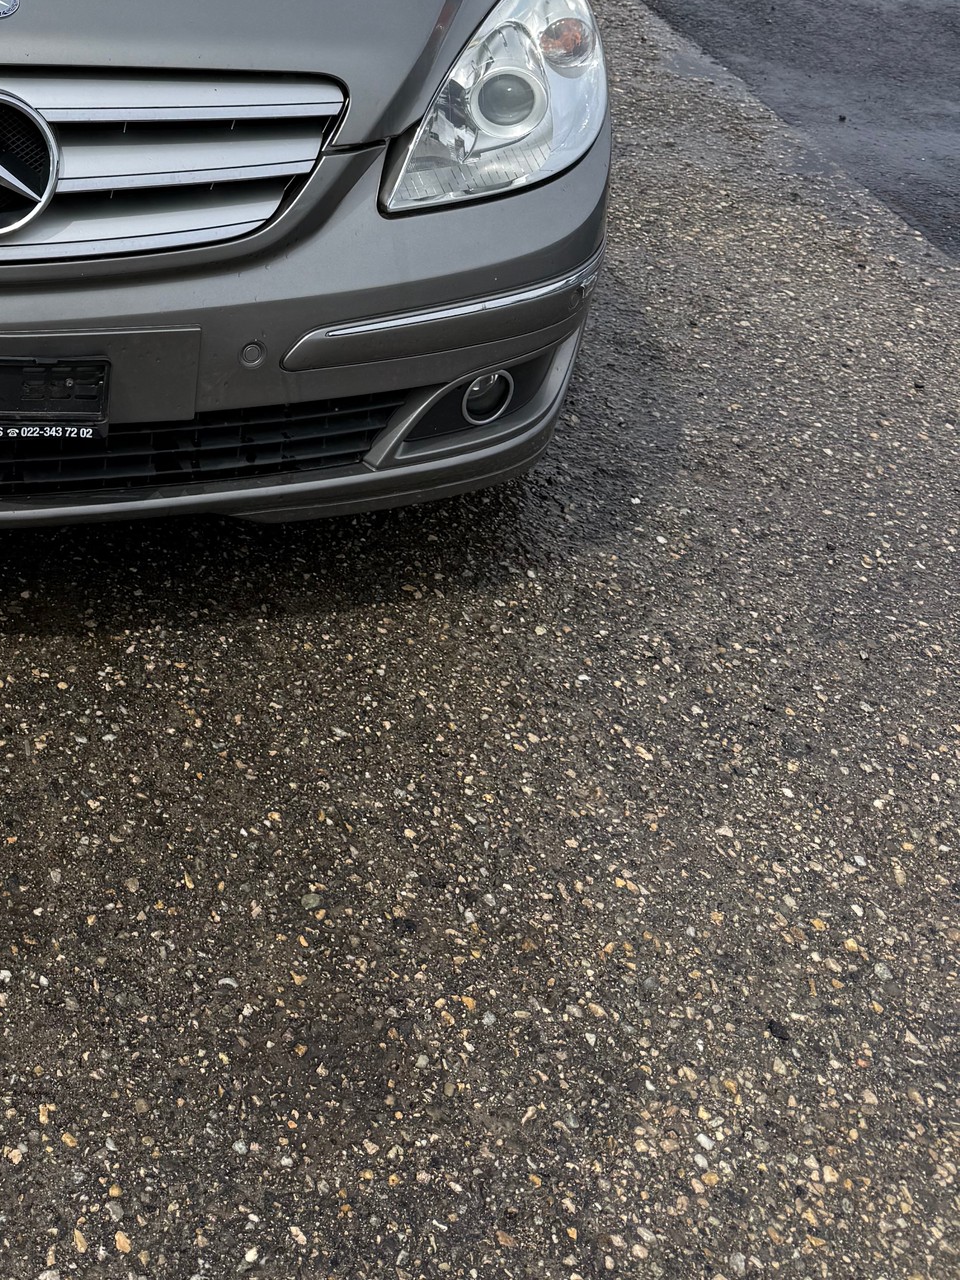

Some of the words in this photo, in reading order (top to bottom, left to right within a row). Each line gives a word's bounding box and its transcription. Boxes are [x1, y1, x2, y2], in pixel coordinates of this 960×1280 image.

[21, 426, 63, 437] 022-343
[64, 427, 78, 438] 72
[79, 428, 93, 439] 02
